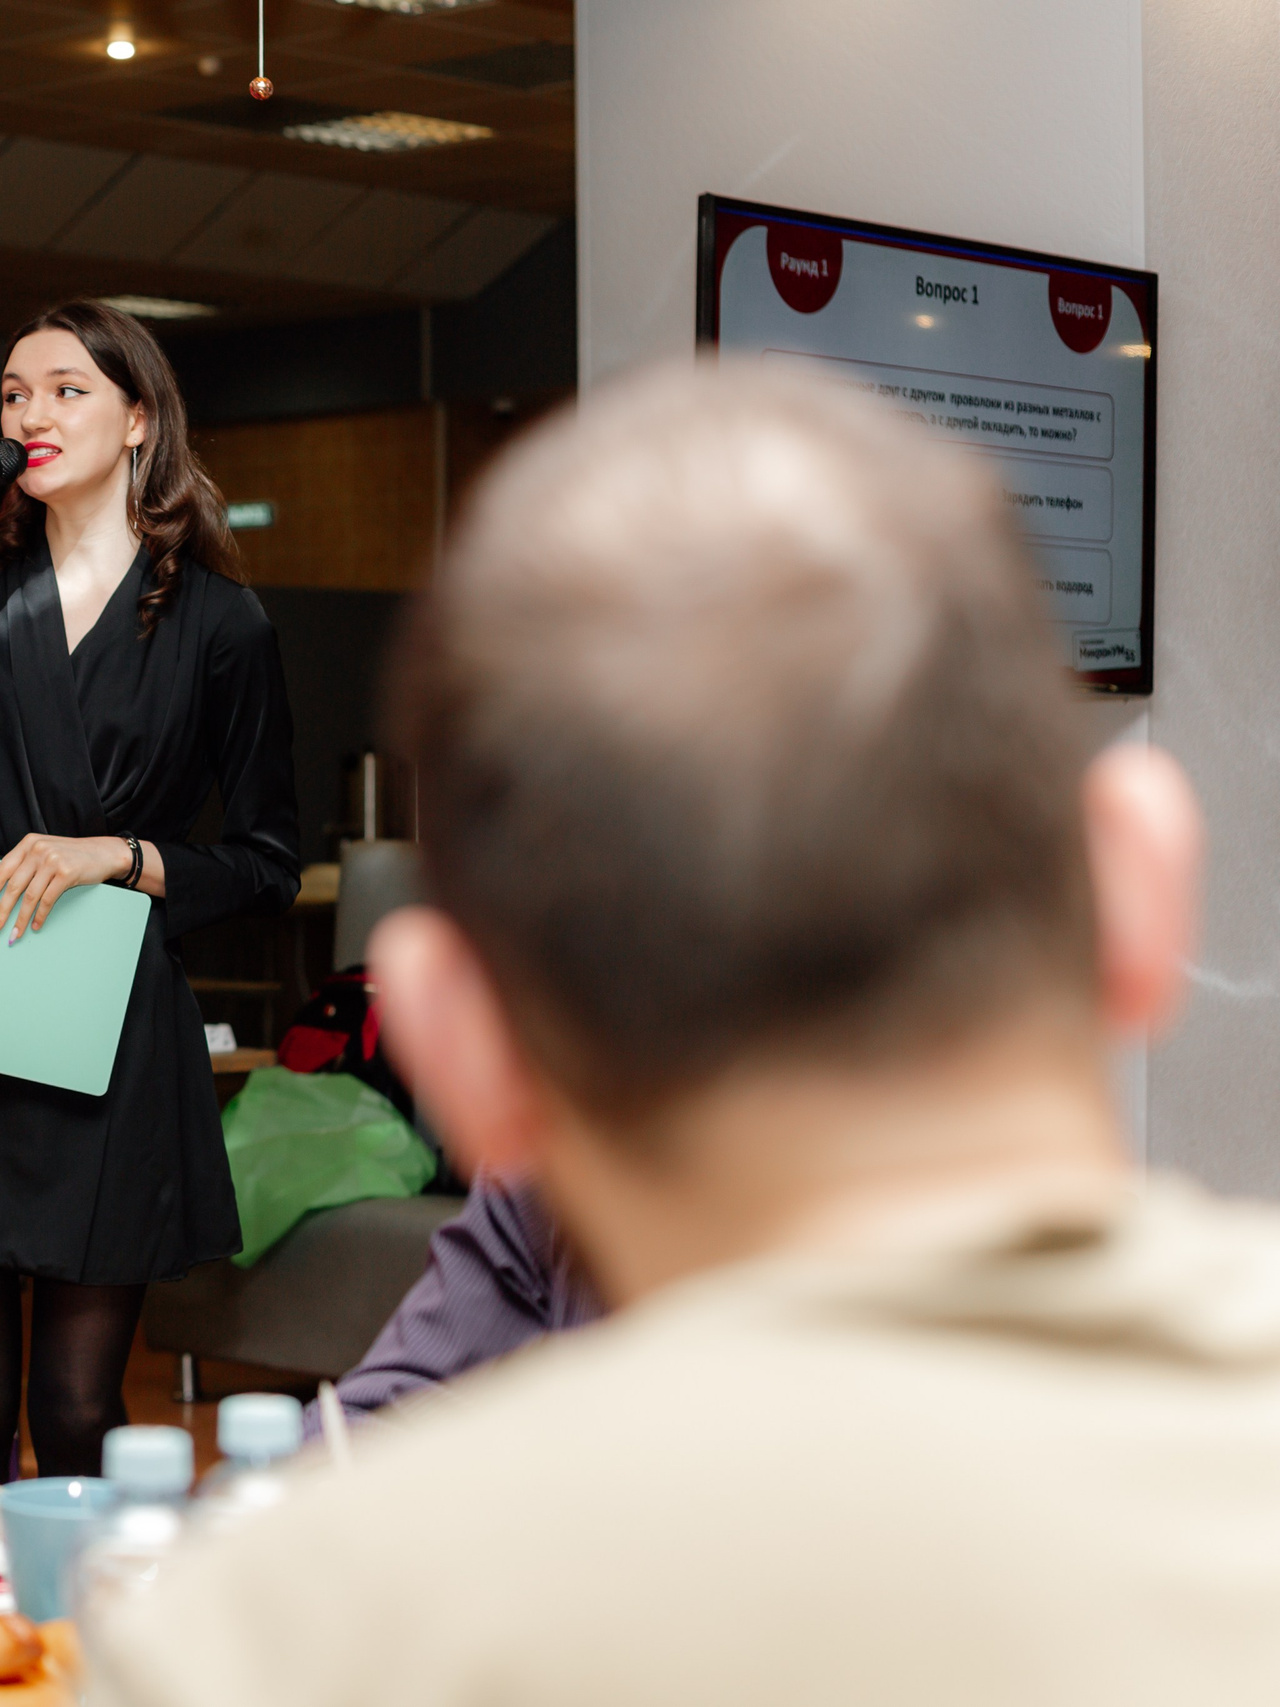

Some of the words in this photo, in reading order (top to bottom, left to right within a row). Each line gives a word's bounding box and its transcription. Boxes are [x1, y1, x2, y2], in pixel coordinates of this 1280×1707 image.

[780, 251, 820, 279] Раунд
[821, 258, 829, 277] 1
[916, 275, 967, 305] Вопрос
[972, 285, 980, 305] 1
[1057, 296, 1095, 319] Вопрос
[1097, 304, 1105, 320] 1
[877, 383, 900, 398] друг
[910, 387, 946, 404] другом
[950, 393, 1002, 411] проволоки
[1004, 402, 1015, 412] из
[1017, 402, 1050, 418] разных
[1052, 406, 1094, 422] металлов
[1096, 411, 1102, 423] с
[946, 415, 979, 431] другой
[1029, 425, 1039, 437] то
[1041, 427, 1078, 441] можно?
[1045, 495, 1083, 513] телефон
[1056, 580, 1094, 597] водород
